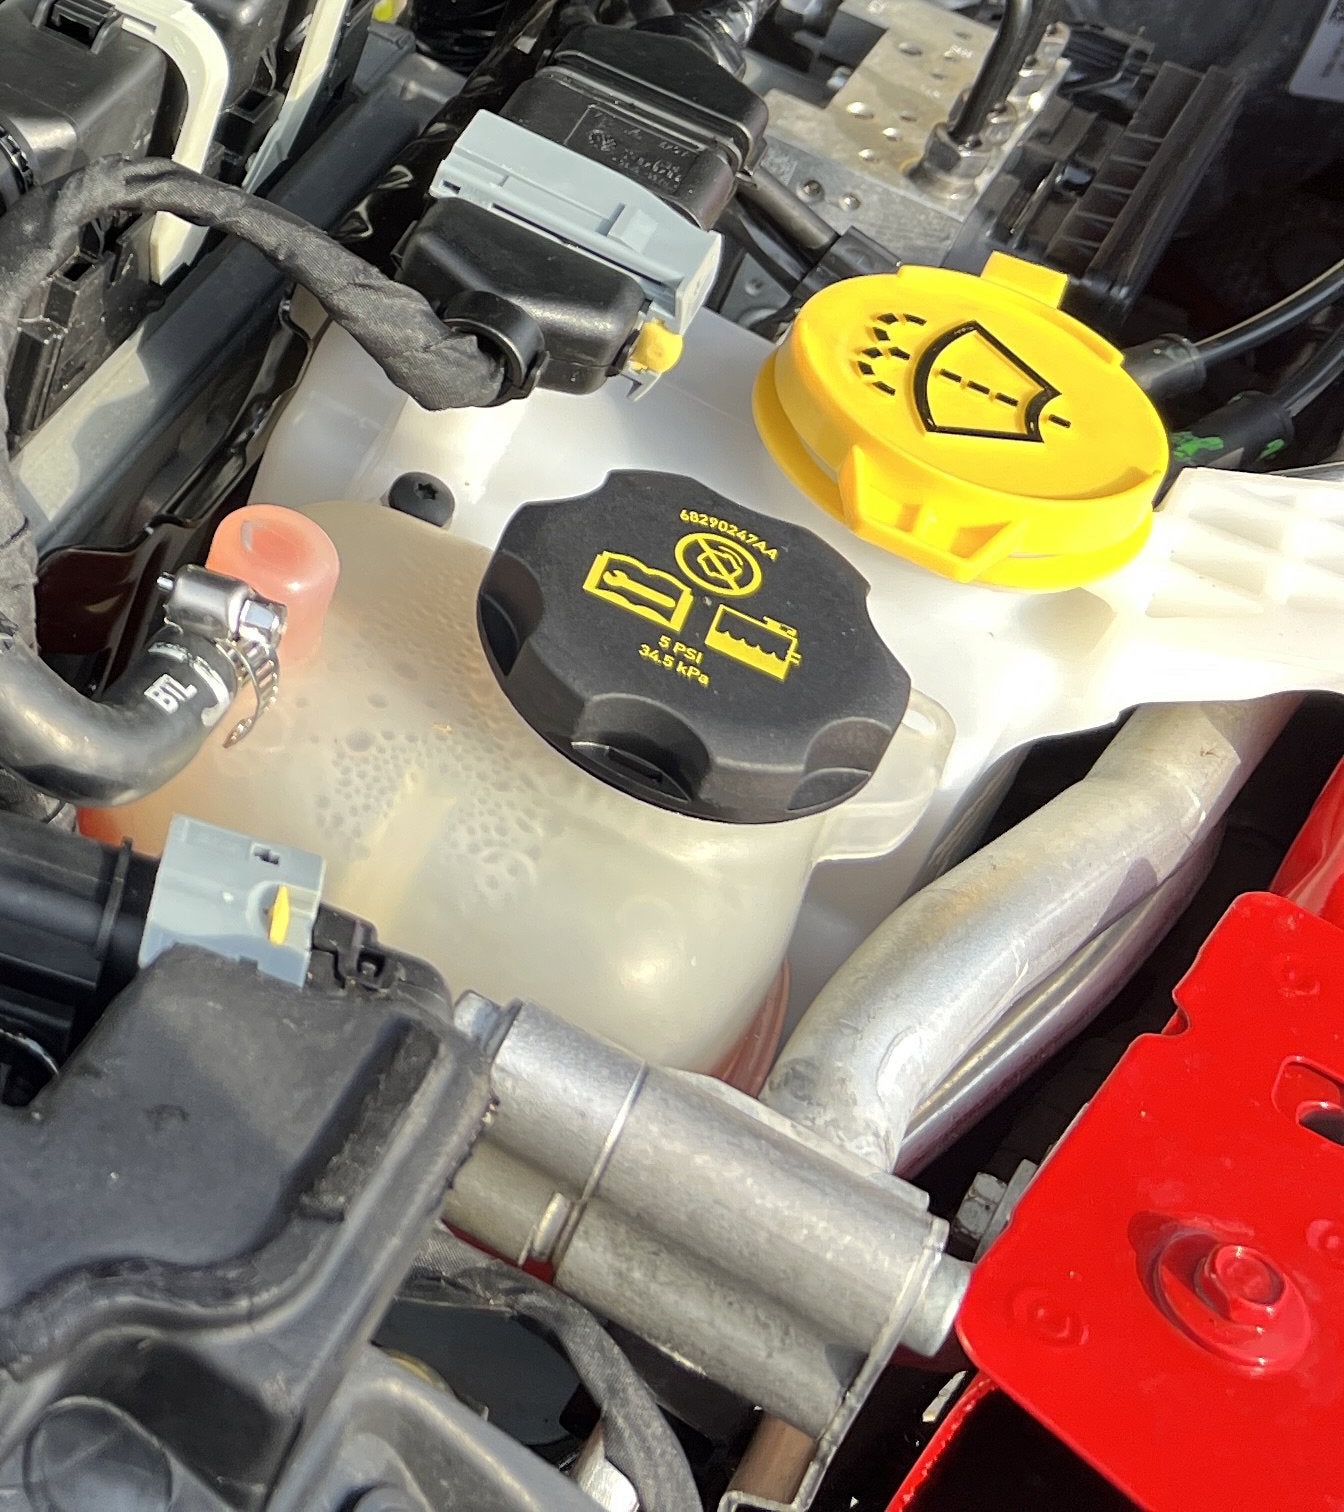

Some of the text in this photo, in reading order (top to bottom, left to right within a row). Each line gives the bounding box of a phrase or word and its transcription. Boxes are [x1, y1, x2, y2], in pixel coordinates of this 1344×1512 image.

[679, 509, 779, 561] 68290247AA
[638, 643, 710, 687] 34.5 kPa
[658, 635, 703, 664] 5 PSI
